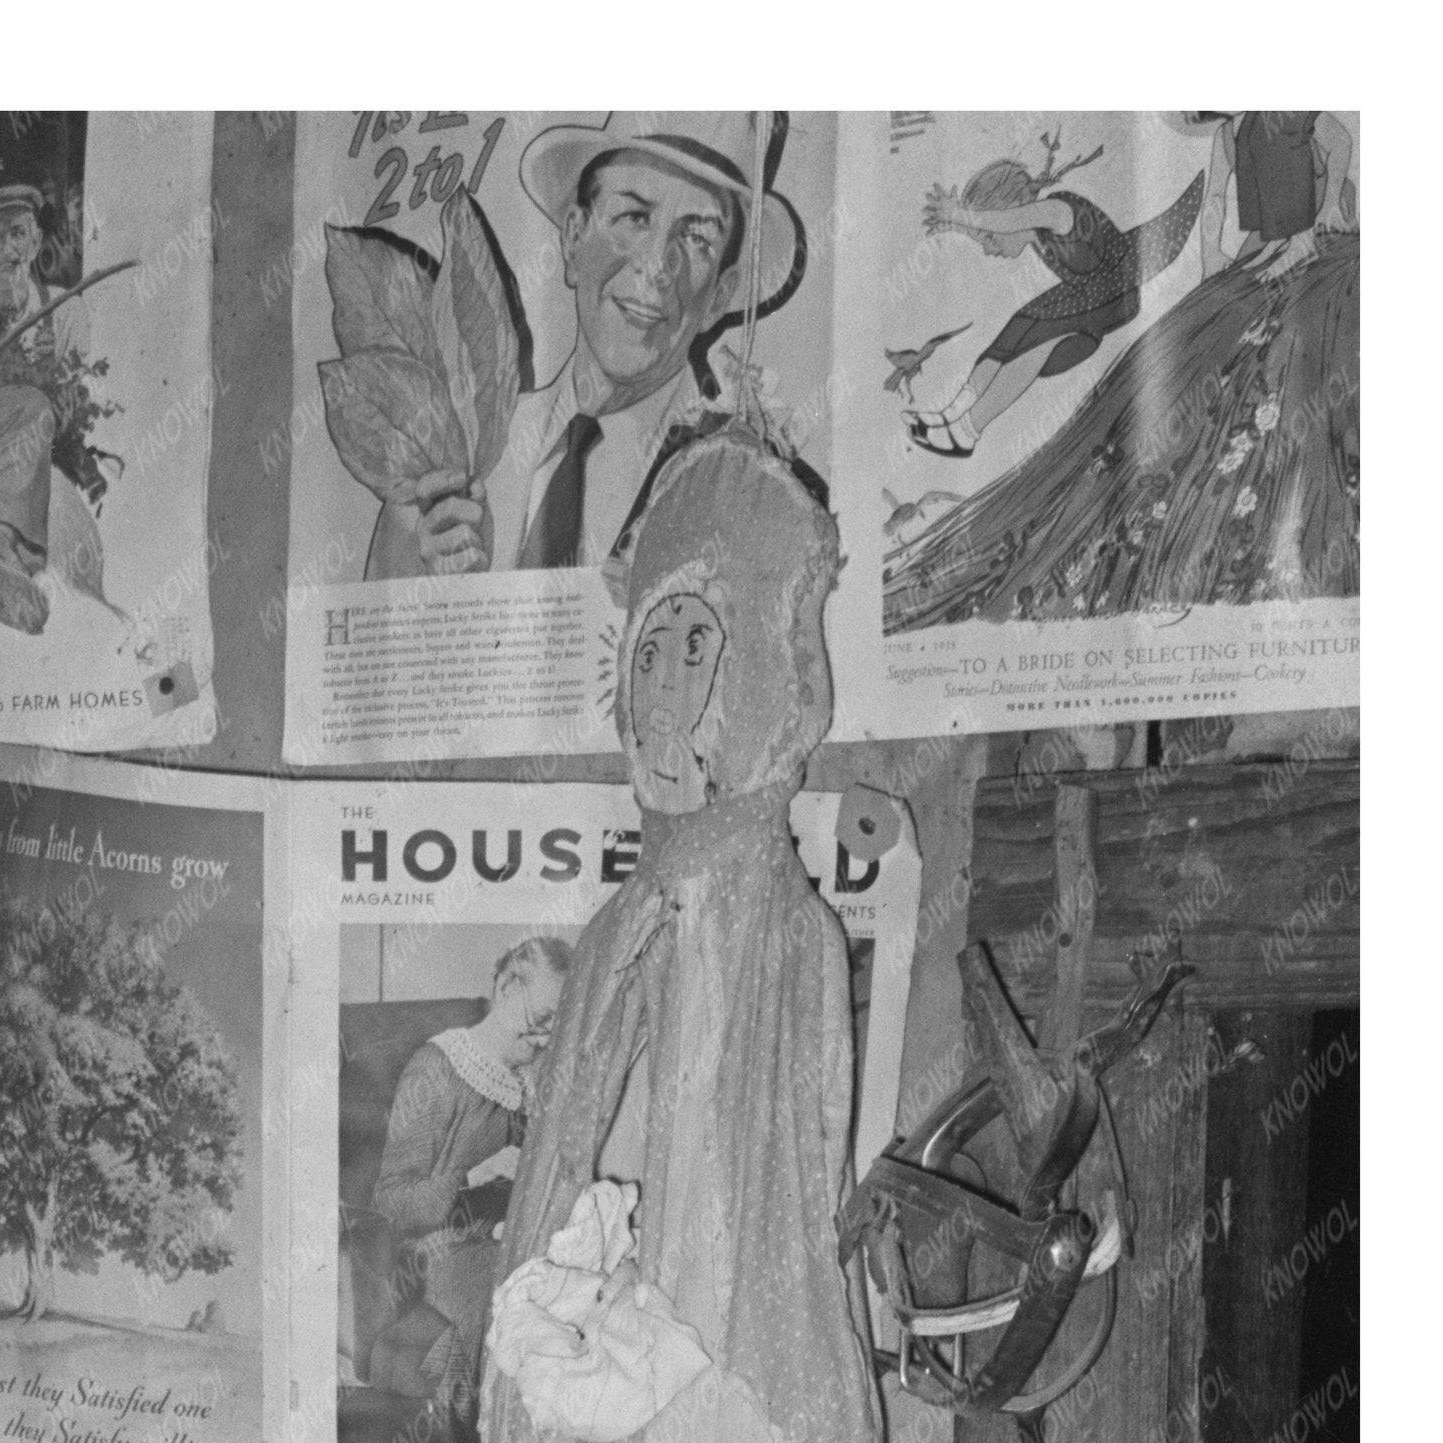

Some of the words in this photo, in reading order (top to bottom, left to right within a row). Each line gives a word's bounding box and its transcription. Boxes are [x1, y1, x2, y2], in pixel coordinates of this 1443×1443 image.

[364, 147, 408, 226] 2
[409, 145, 464, 210] to
[468, 117, 505, 195] 1
[996, 657, 1008, 673] A
[1018, 651, 1076, 671] BRIDE
[1085, 650, 1113, 667] ON
[1124, 642, 1238, 669] SELECTING
[12, 694, 60, 713] FARM
[69, 689, 143, 711] HOMES
[1006, 701, 1045, 711] MORE
[1055, 699, 1090, 710] THAN
[1183, 690, 1237, 701] COPIES
[341, 807, 373, 819] THE
[6, 816, 40, 858] from
[43, 823, 84, 864] little
[87, 830, 162, 875] Acorns
[170, 856, 230, 889] grow
[341, 893, 434, 905] MAGAZINE
[23, 1373, 63, 1408] they
[69, 1376, 172, 1421] Satisfied
[173, 1402, 212, 1420] one
